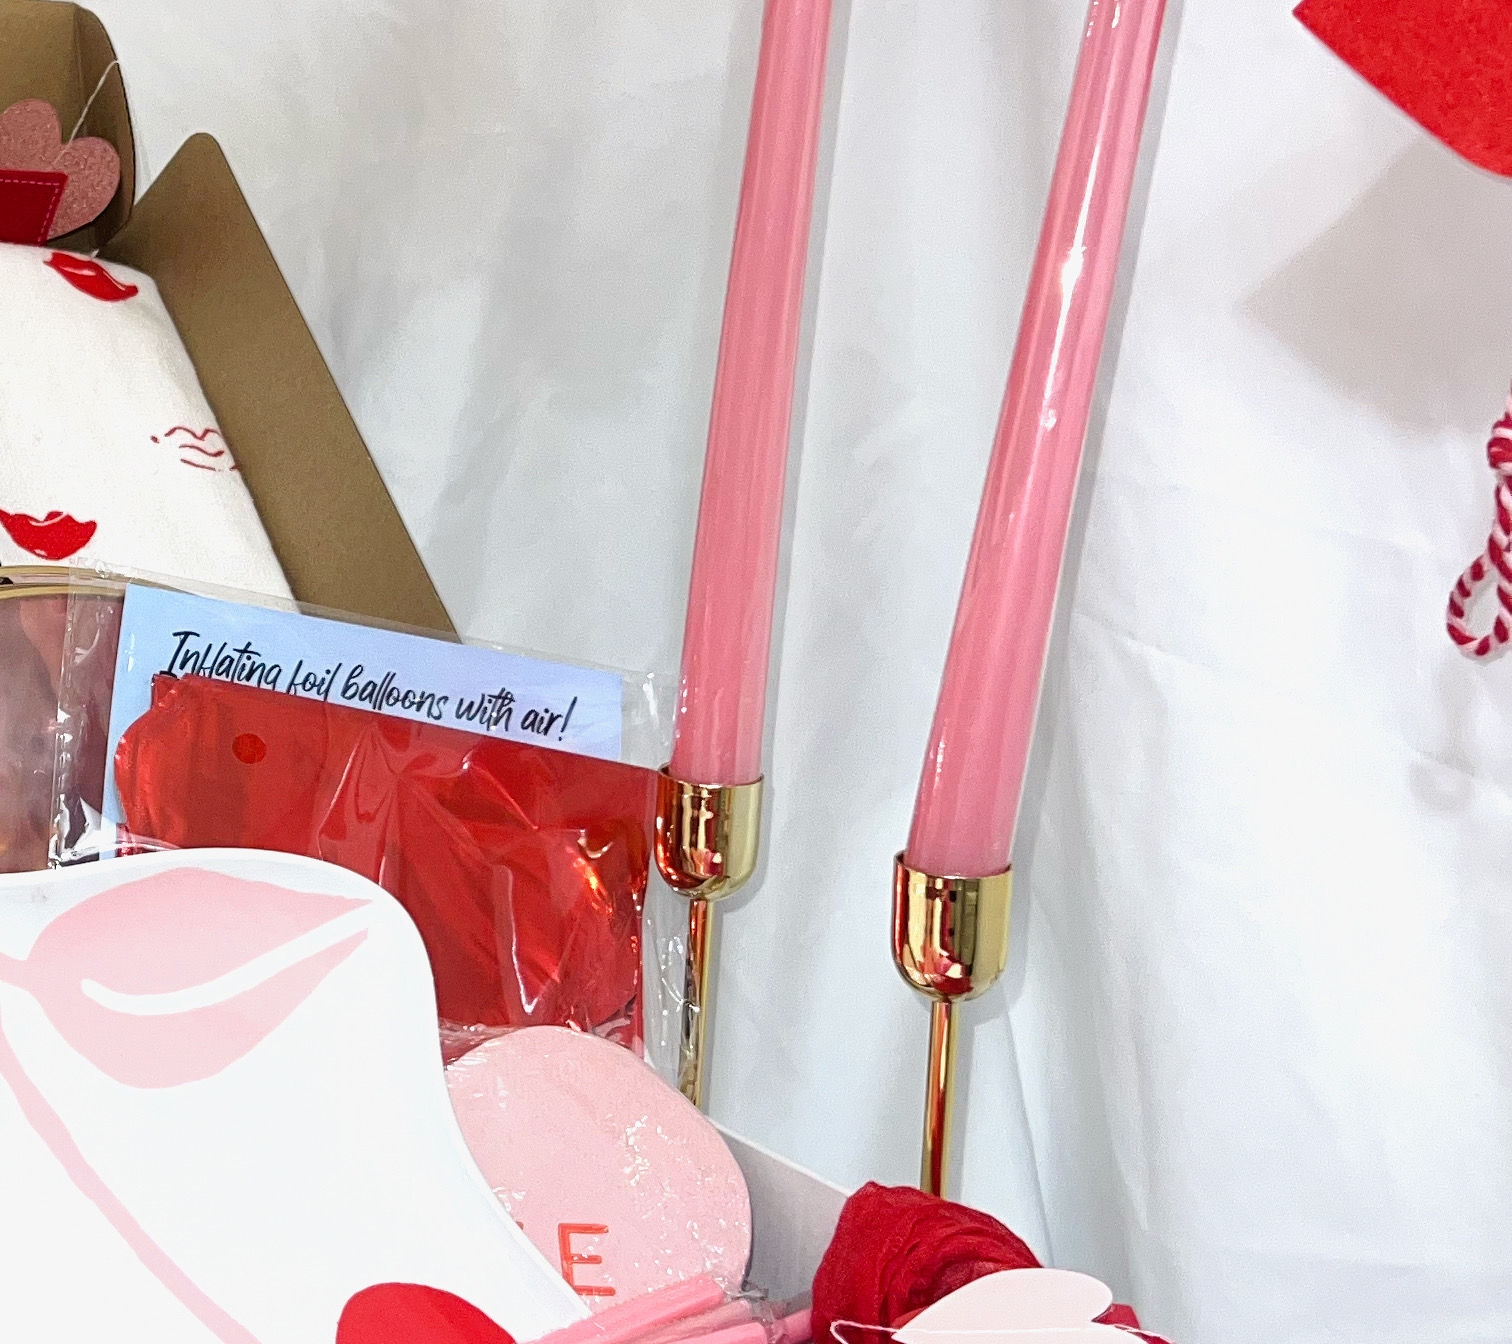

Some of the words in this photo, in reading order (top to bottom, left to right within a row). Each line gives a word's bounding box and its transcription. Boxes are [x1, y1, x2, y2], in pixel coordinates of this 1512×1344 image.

[160, 630, 283, 691] Inflating
[286, 659, 343, 702] foil
[341, 664, 448, 721] balloons
[455, 687, 515, 732] with
[520, 696, 578, 742] air!
